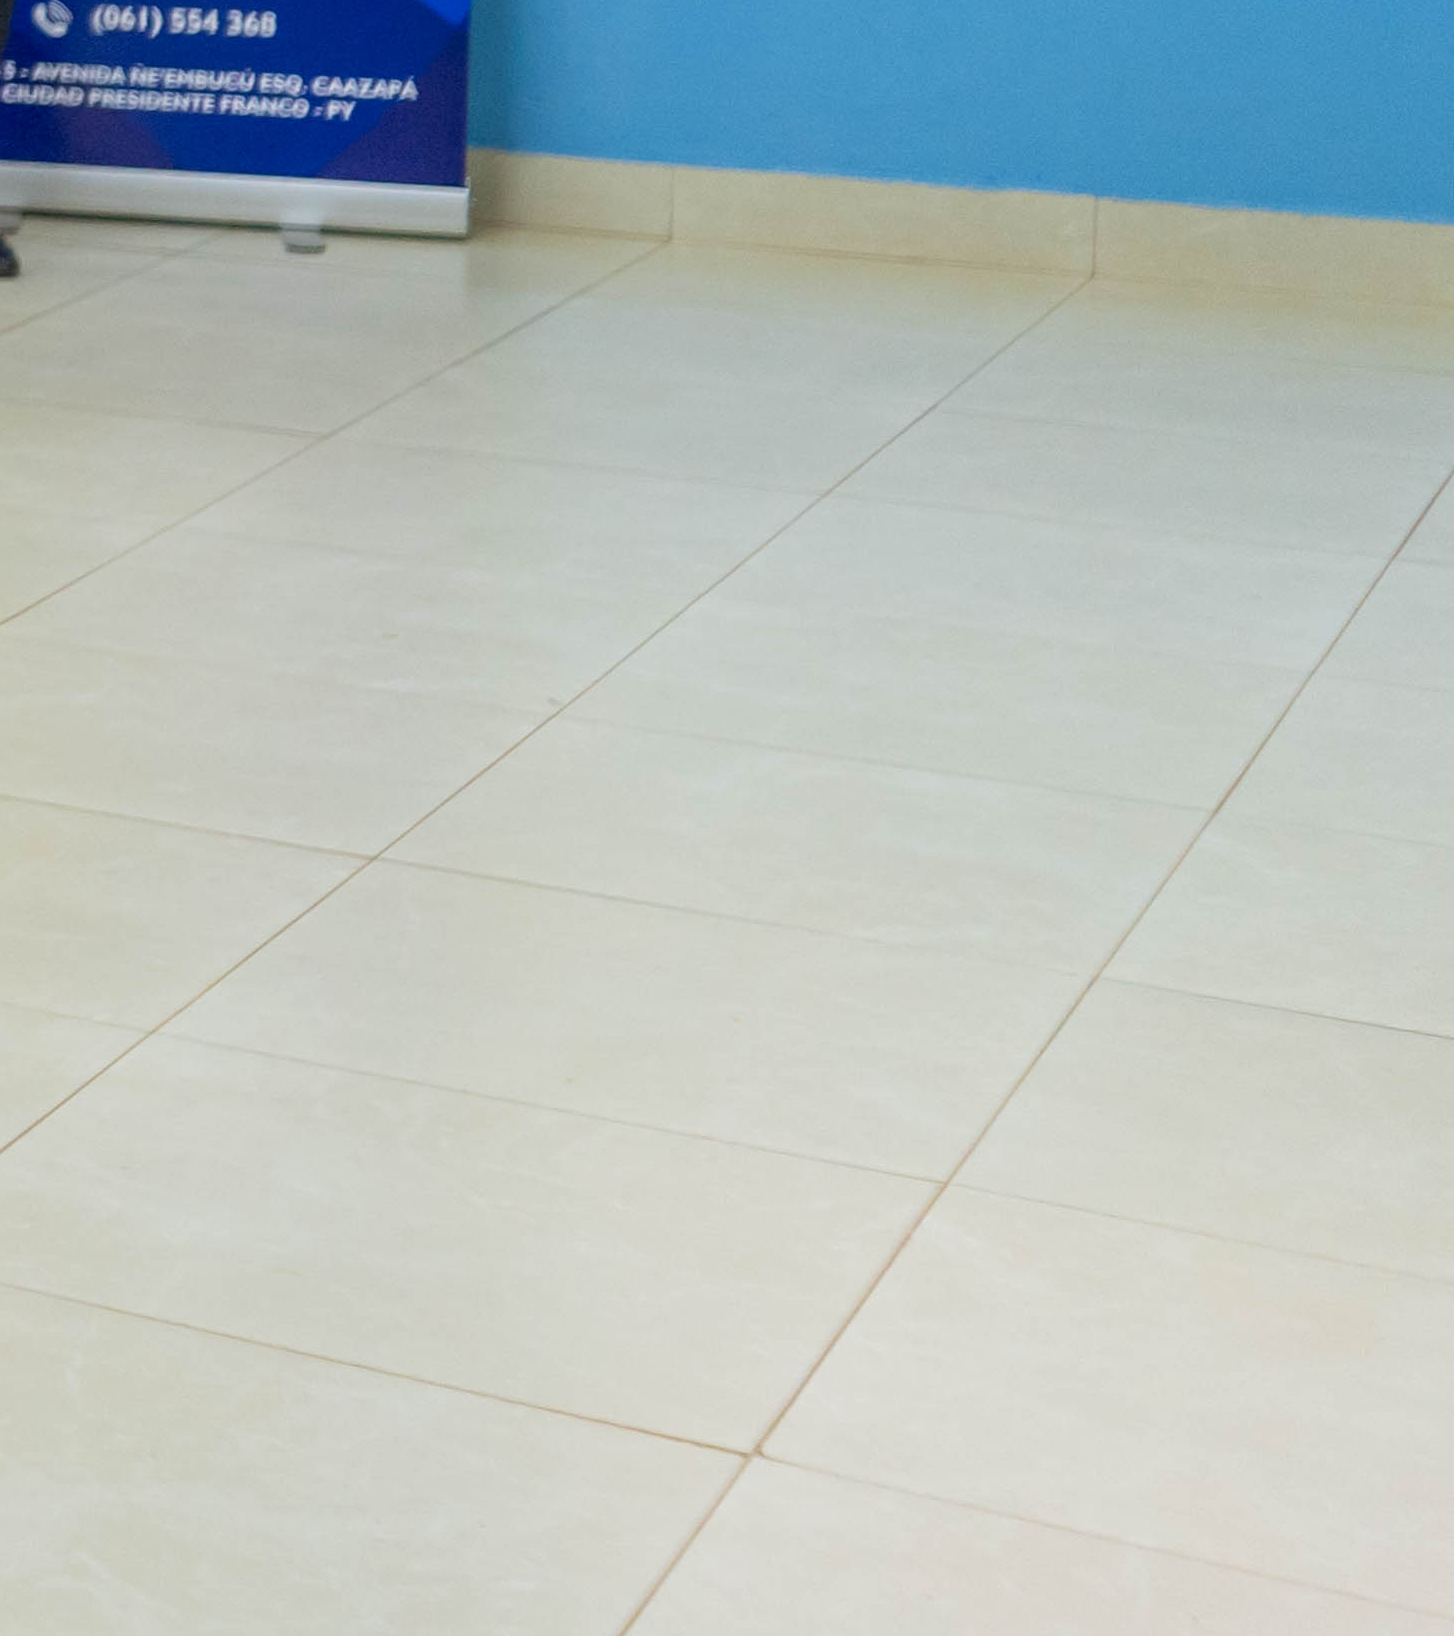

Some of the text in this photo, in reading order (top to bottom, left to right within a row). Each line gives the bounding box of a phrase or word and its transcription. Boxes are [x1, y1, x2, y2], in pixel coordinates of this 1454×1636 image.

[88, 3, 277, 39] (061) 554 368
[30, 62, 127, 86] AVENIDA
[311, 75, 419, 101] CAAZAPÁ
[0, 83, 85, 107] CIUDAD
[87, 87, 216, 114] PRESIDENTE
[220, 94, 310, 119] FRANCO
[325, 100, 356, 122] PY
